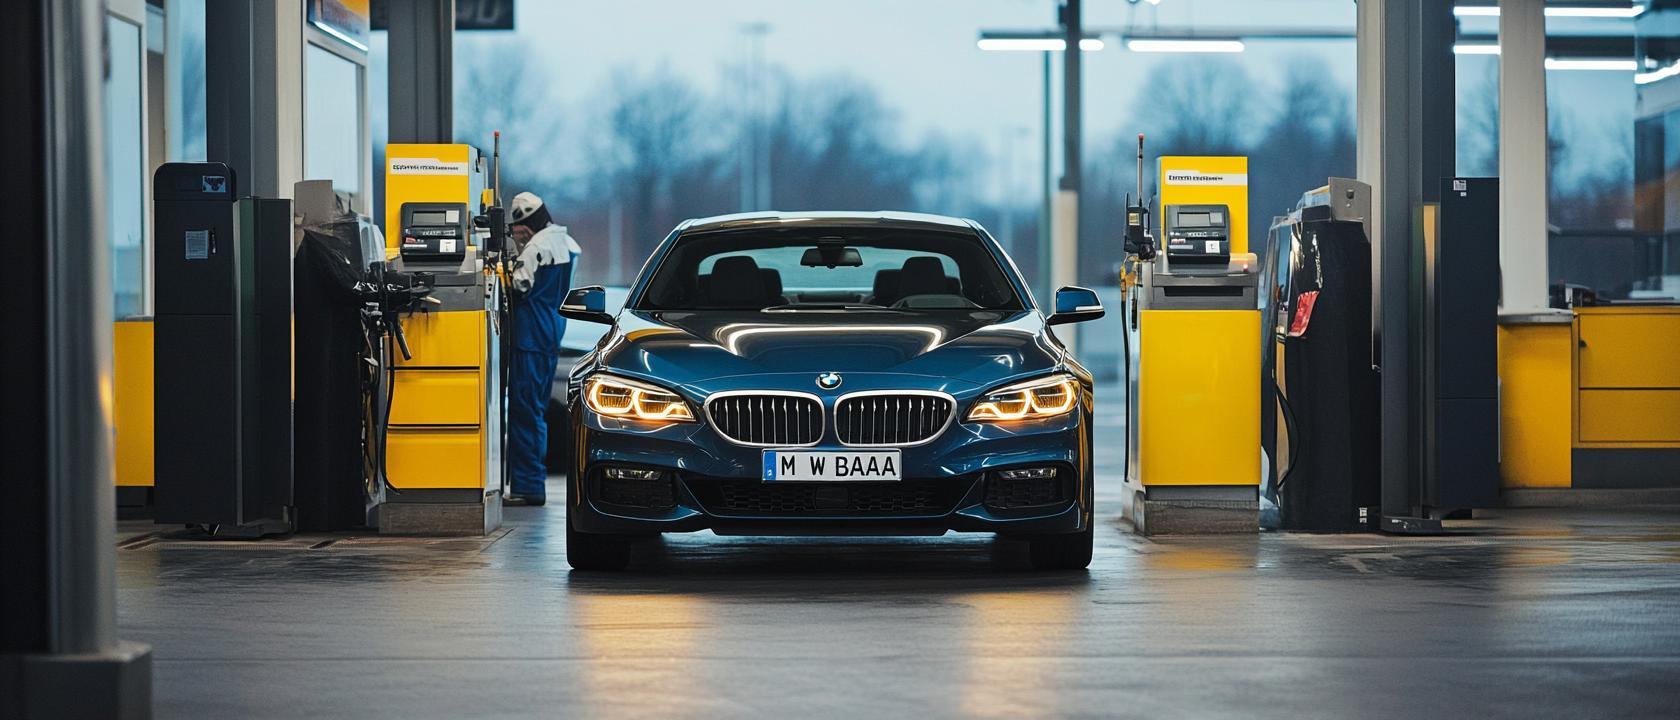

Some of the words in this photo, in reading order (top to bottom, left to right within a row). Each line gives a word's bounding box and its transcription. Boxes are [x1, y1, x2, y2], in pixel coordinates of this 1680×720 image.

[781, 455, 795, 476] M
[810, 456, 825, 476] W
[835, 456, 897, 477] BAAA
